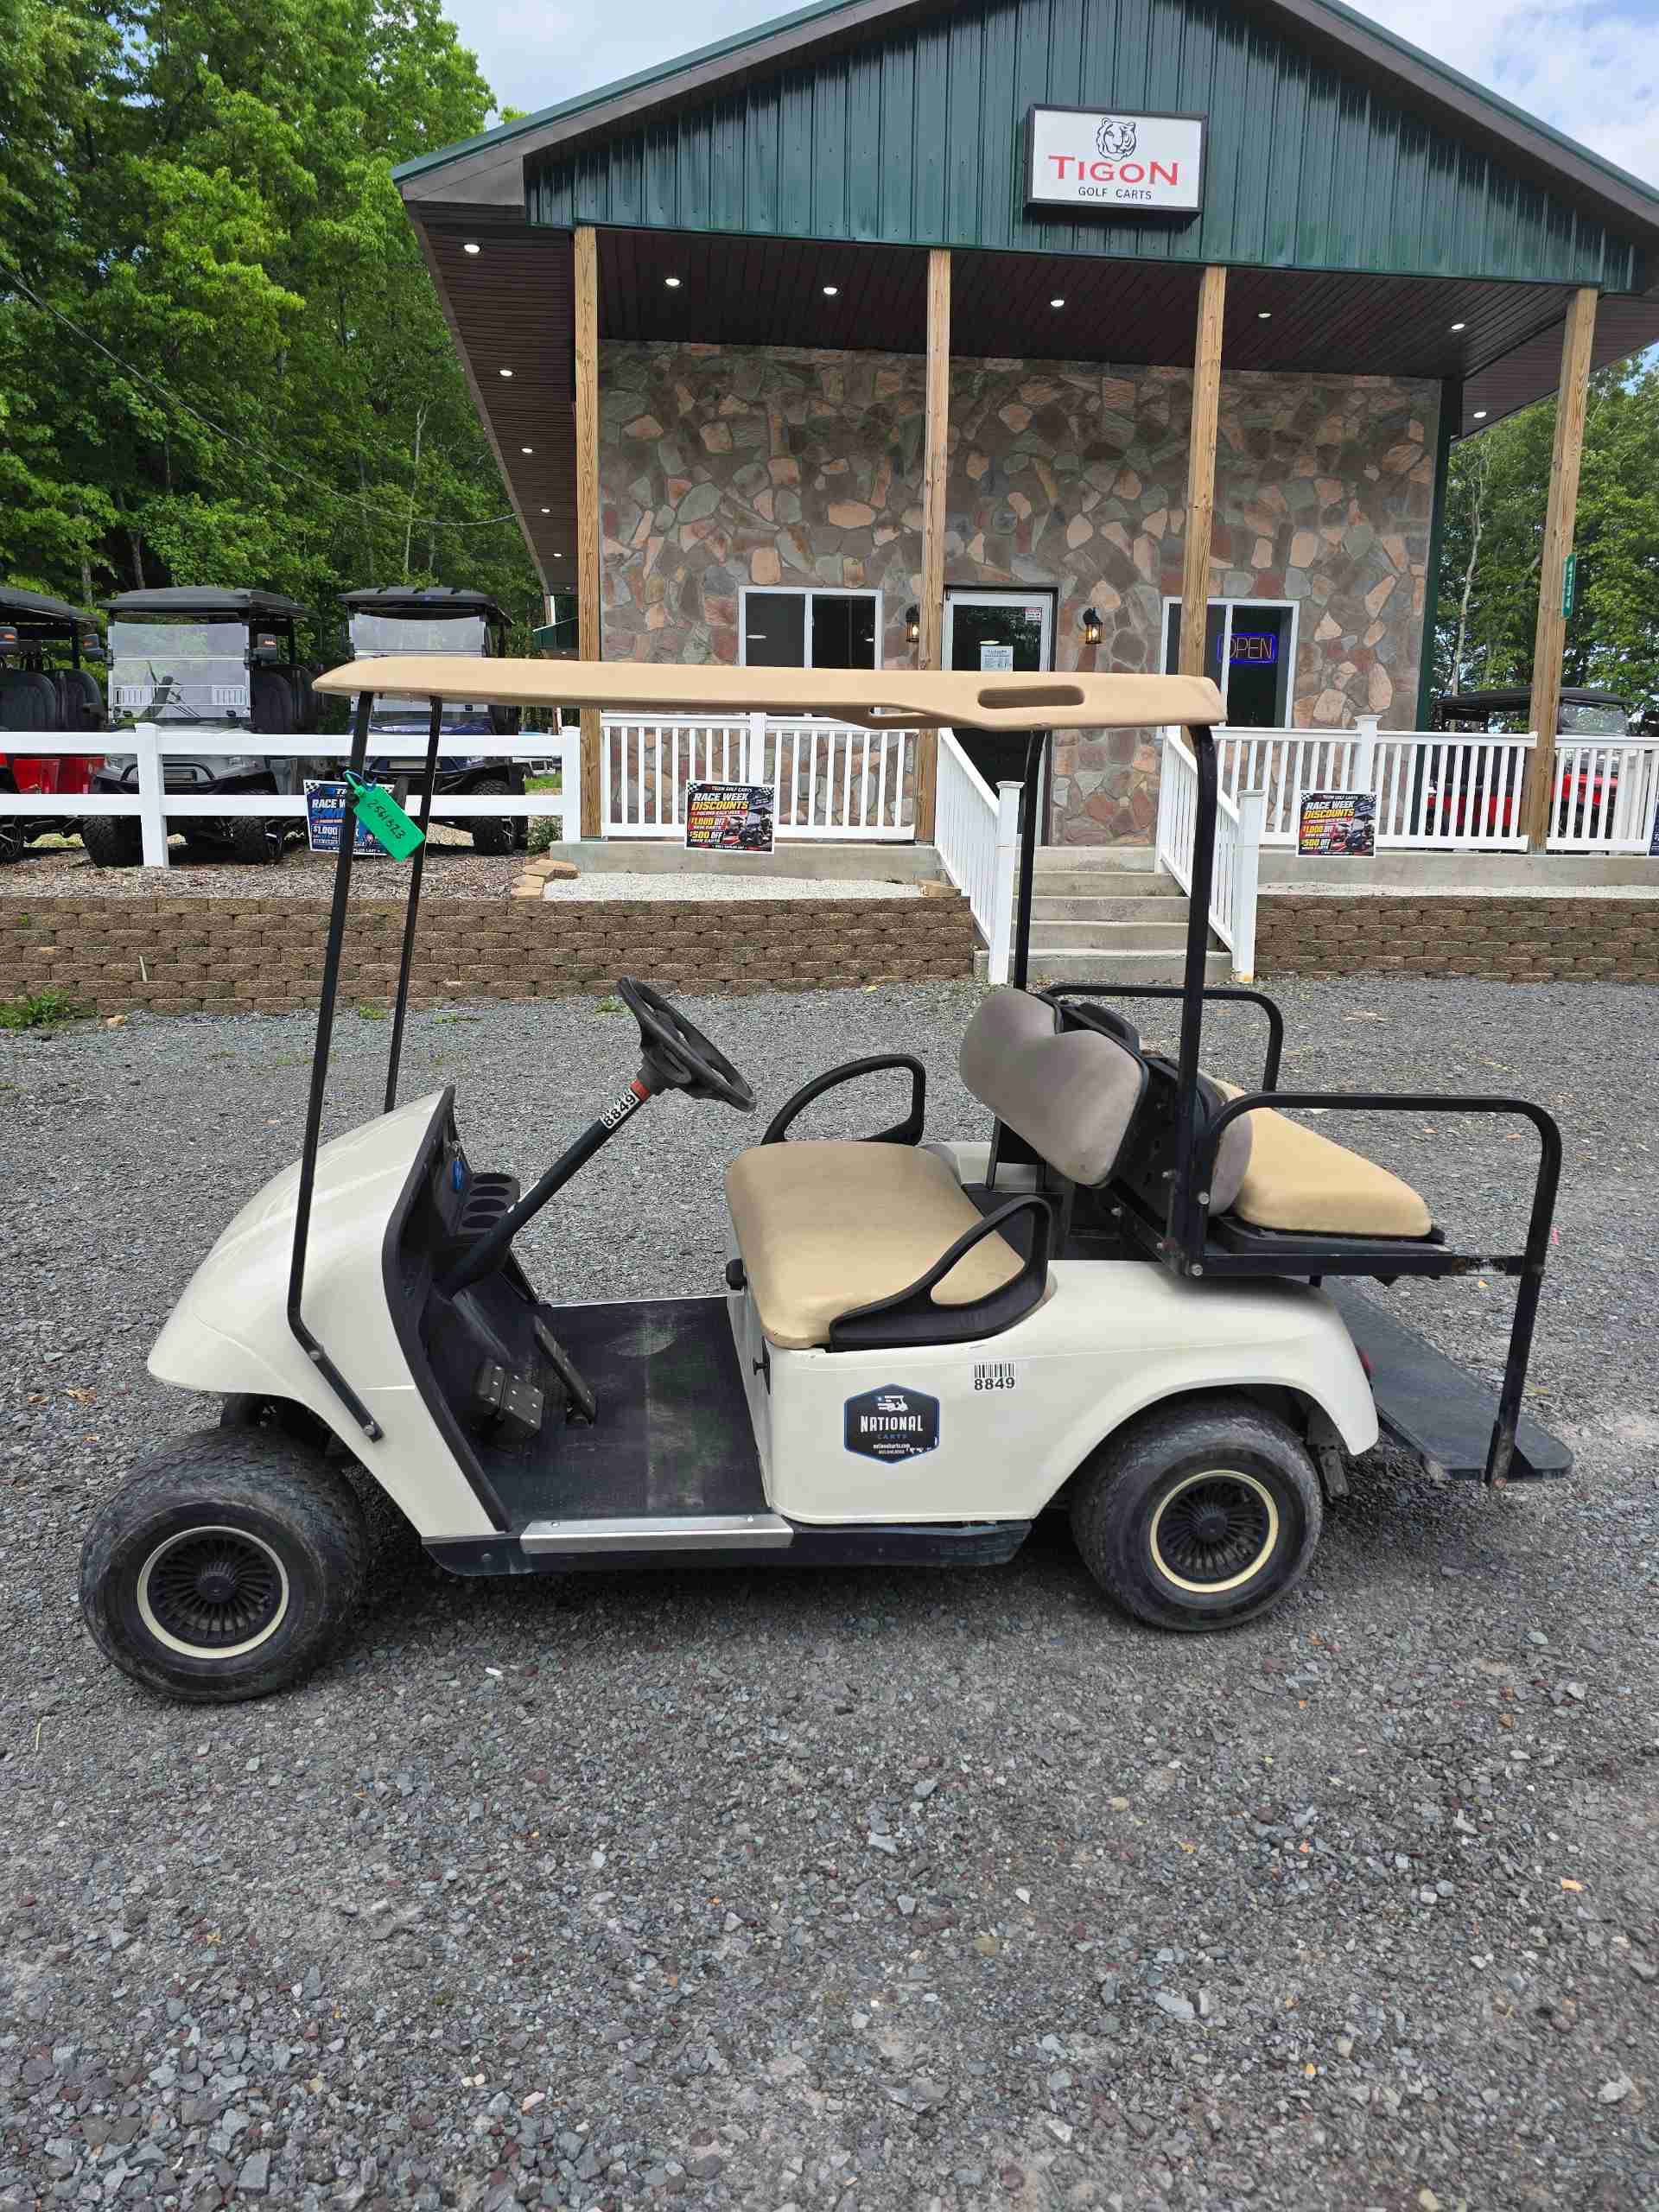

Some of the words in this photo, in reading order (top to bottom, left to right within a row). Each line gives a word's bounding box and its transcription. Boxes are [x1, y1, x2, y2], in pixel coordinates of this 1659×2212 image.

[1048, 155, 1179, 186] TIGON
[1078, 187, 1109, 198] GOLF
[1116, 188, 1153, 200] CARTS
[693, 792, 721, 802] RACE
[722, 792, 748, 801] WEEK
[312, 798, 337, 809] RACE
[691, 801, 749, 810] DISCOUNTS
[1306, 801, 1332, 810] RACE
[1332, 800, 1356, 809] WEEK
[1303, 809, 1355, 819] DISCOUNTS
[690, 830, 710, 839] $500
[605, 1094, 636, 1127] 8849
[974, 1376, 1016, 1391] 8849
[860, 1414, 924, 1433] NATIONAL
